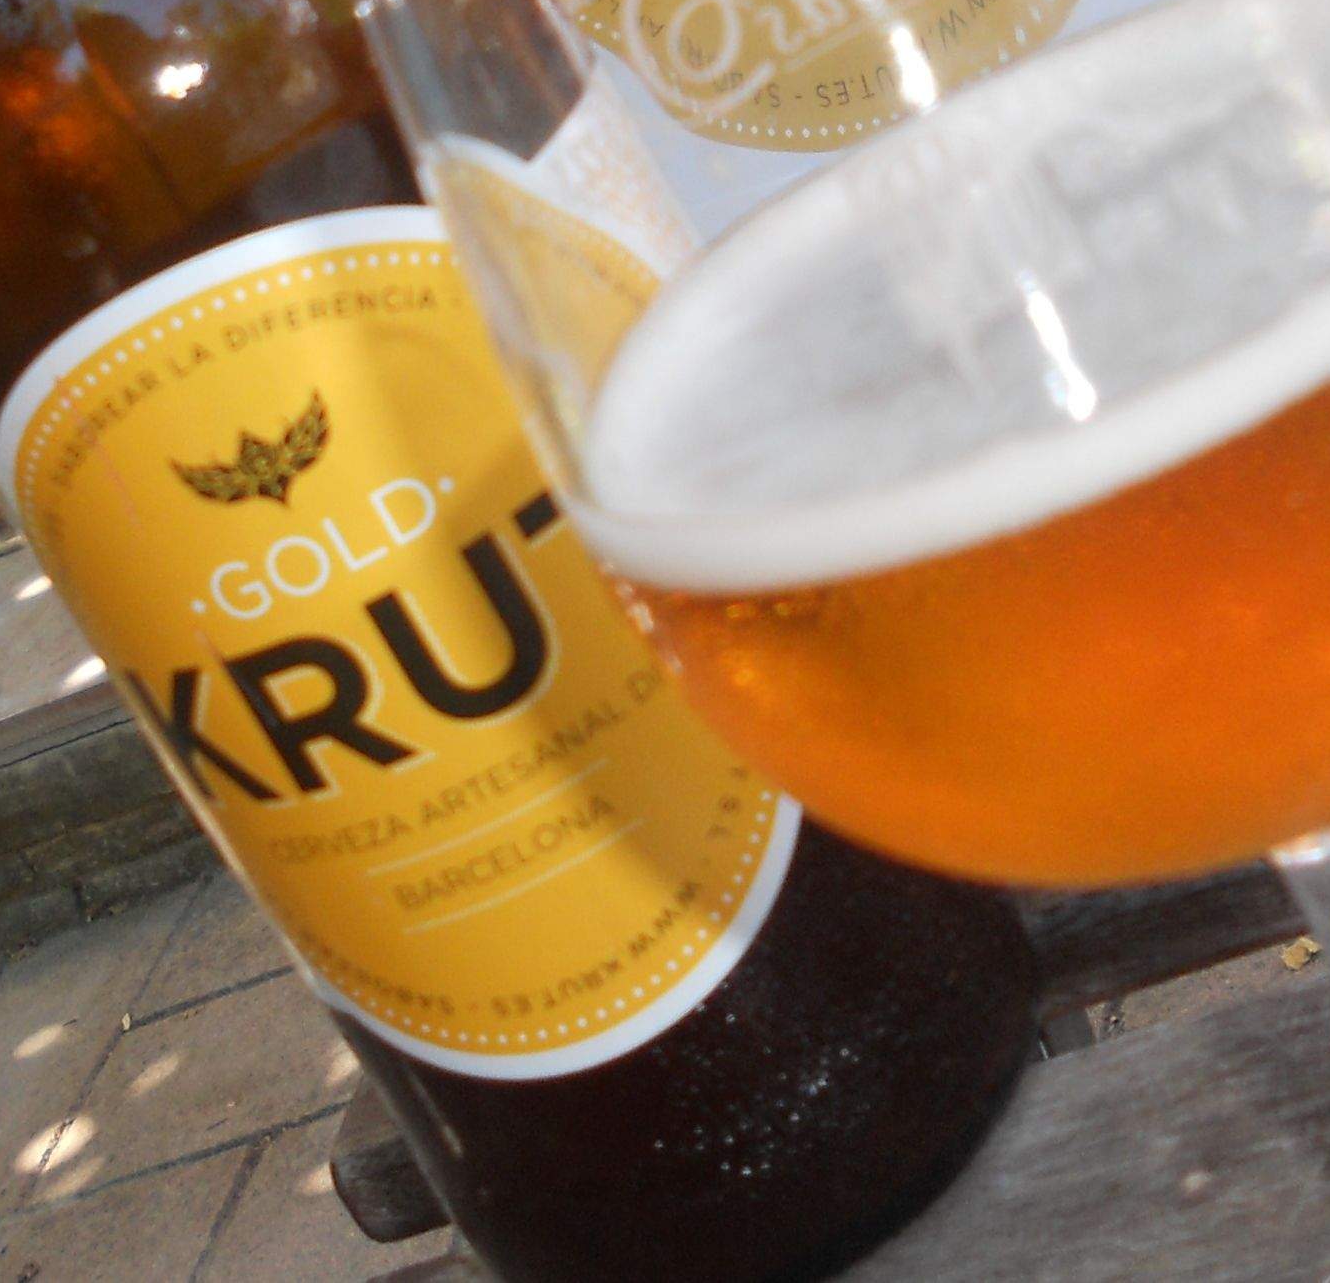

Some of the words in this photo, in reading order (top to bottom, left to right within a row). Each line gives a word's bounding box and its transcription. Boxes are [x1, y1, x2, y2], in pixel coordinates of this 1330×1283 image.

[170, 341, 212, 379] LA
[221, 283, 438, 352] DIFERENCIA
[210, 477, 437, 620] GOLD
[125, 489, 562, 802] KRU
[419, 700, 620, 827] ARTESANAL
[391, 795, 615, 912] BARCELONA
